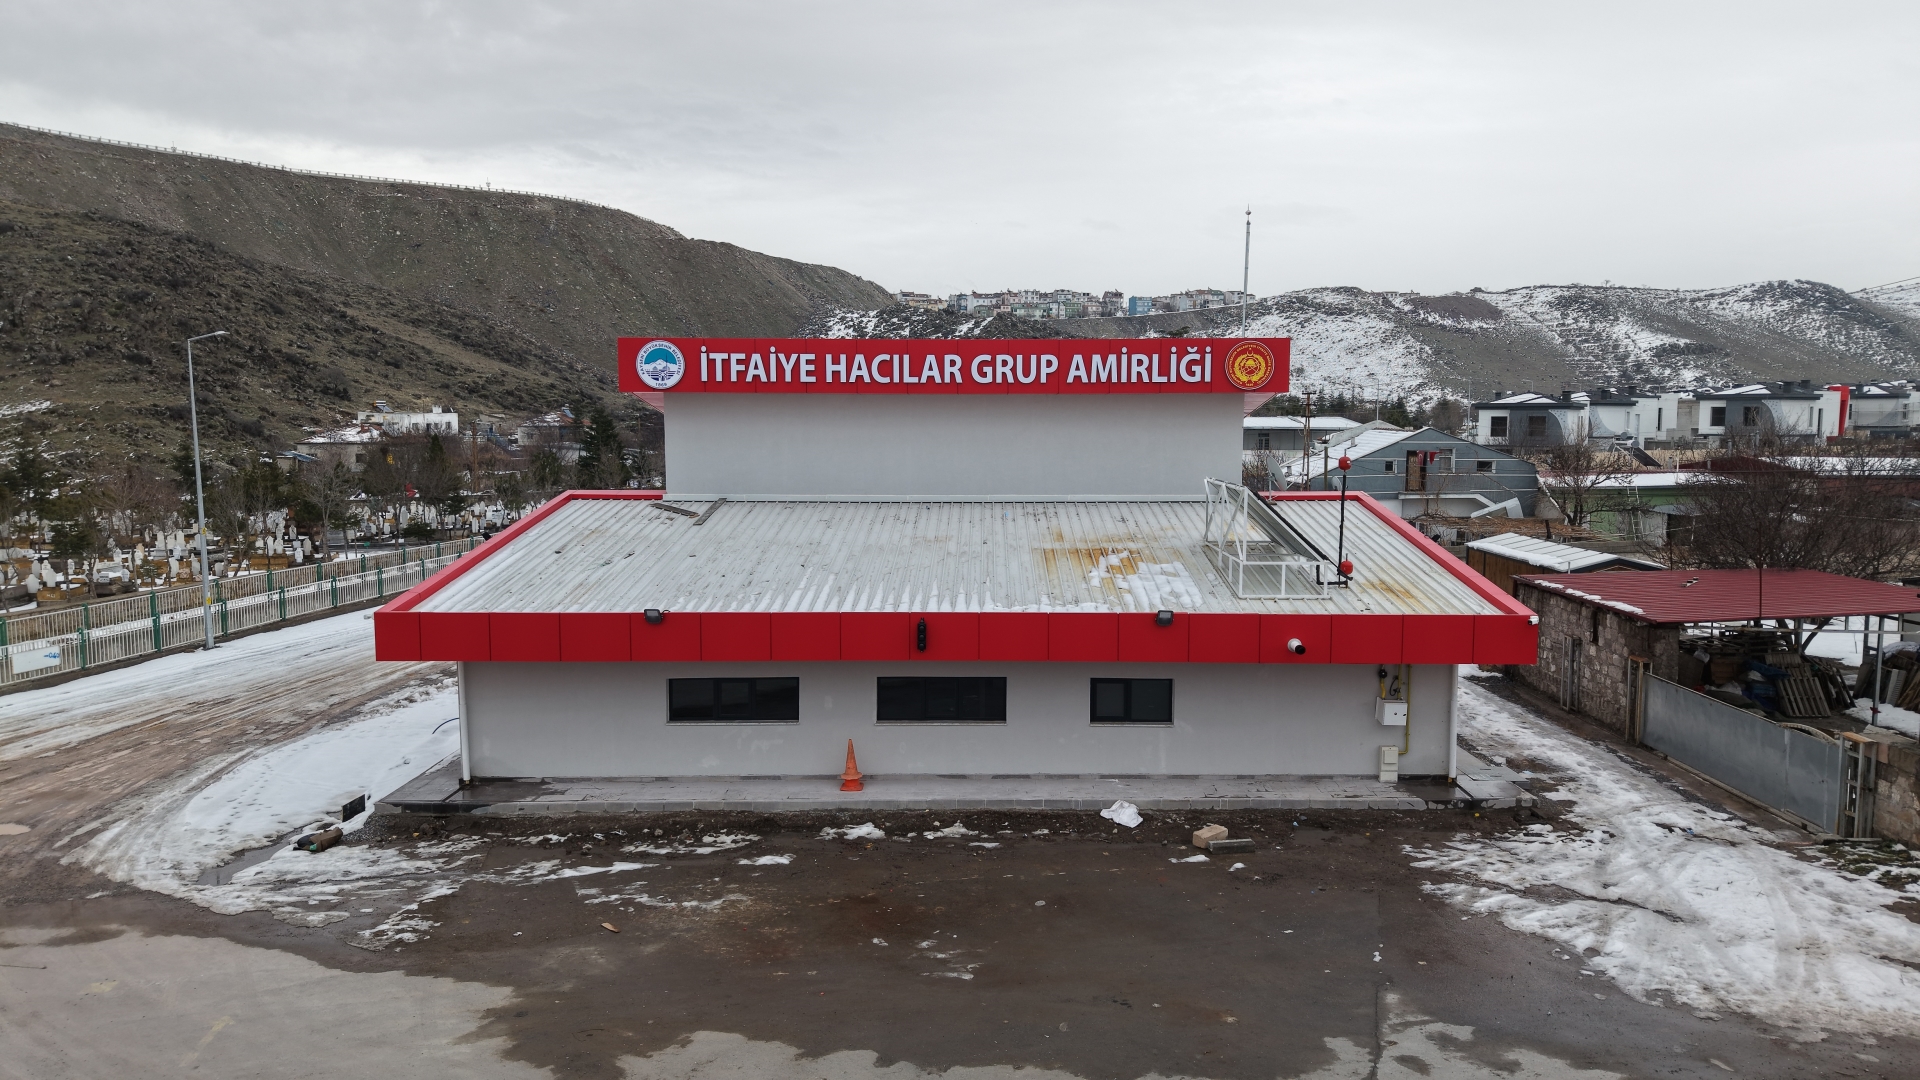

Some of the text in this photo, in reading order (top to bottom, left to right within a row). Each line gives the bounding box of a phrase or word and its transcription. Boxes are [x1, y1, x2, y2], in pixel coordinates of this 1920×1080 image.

[700, 346, 816, 382] İTFAİYE
[825, 353, 963, 384] HACILAR
[970, 354, 1059, 384] GRUP
[1066, 346, 1212, 383] AMİRLİĞİ
